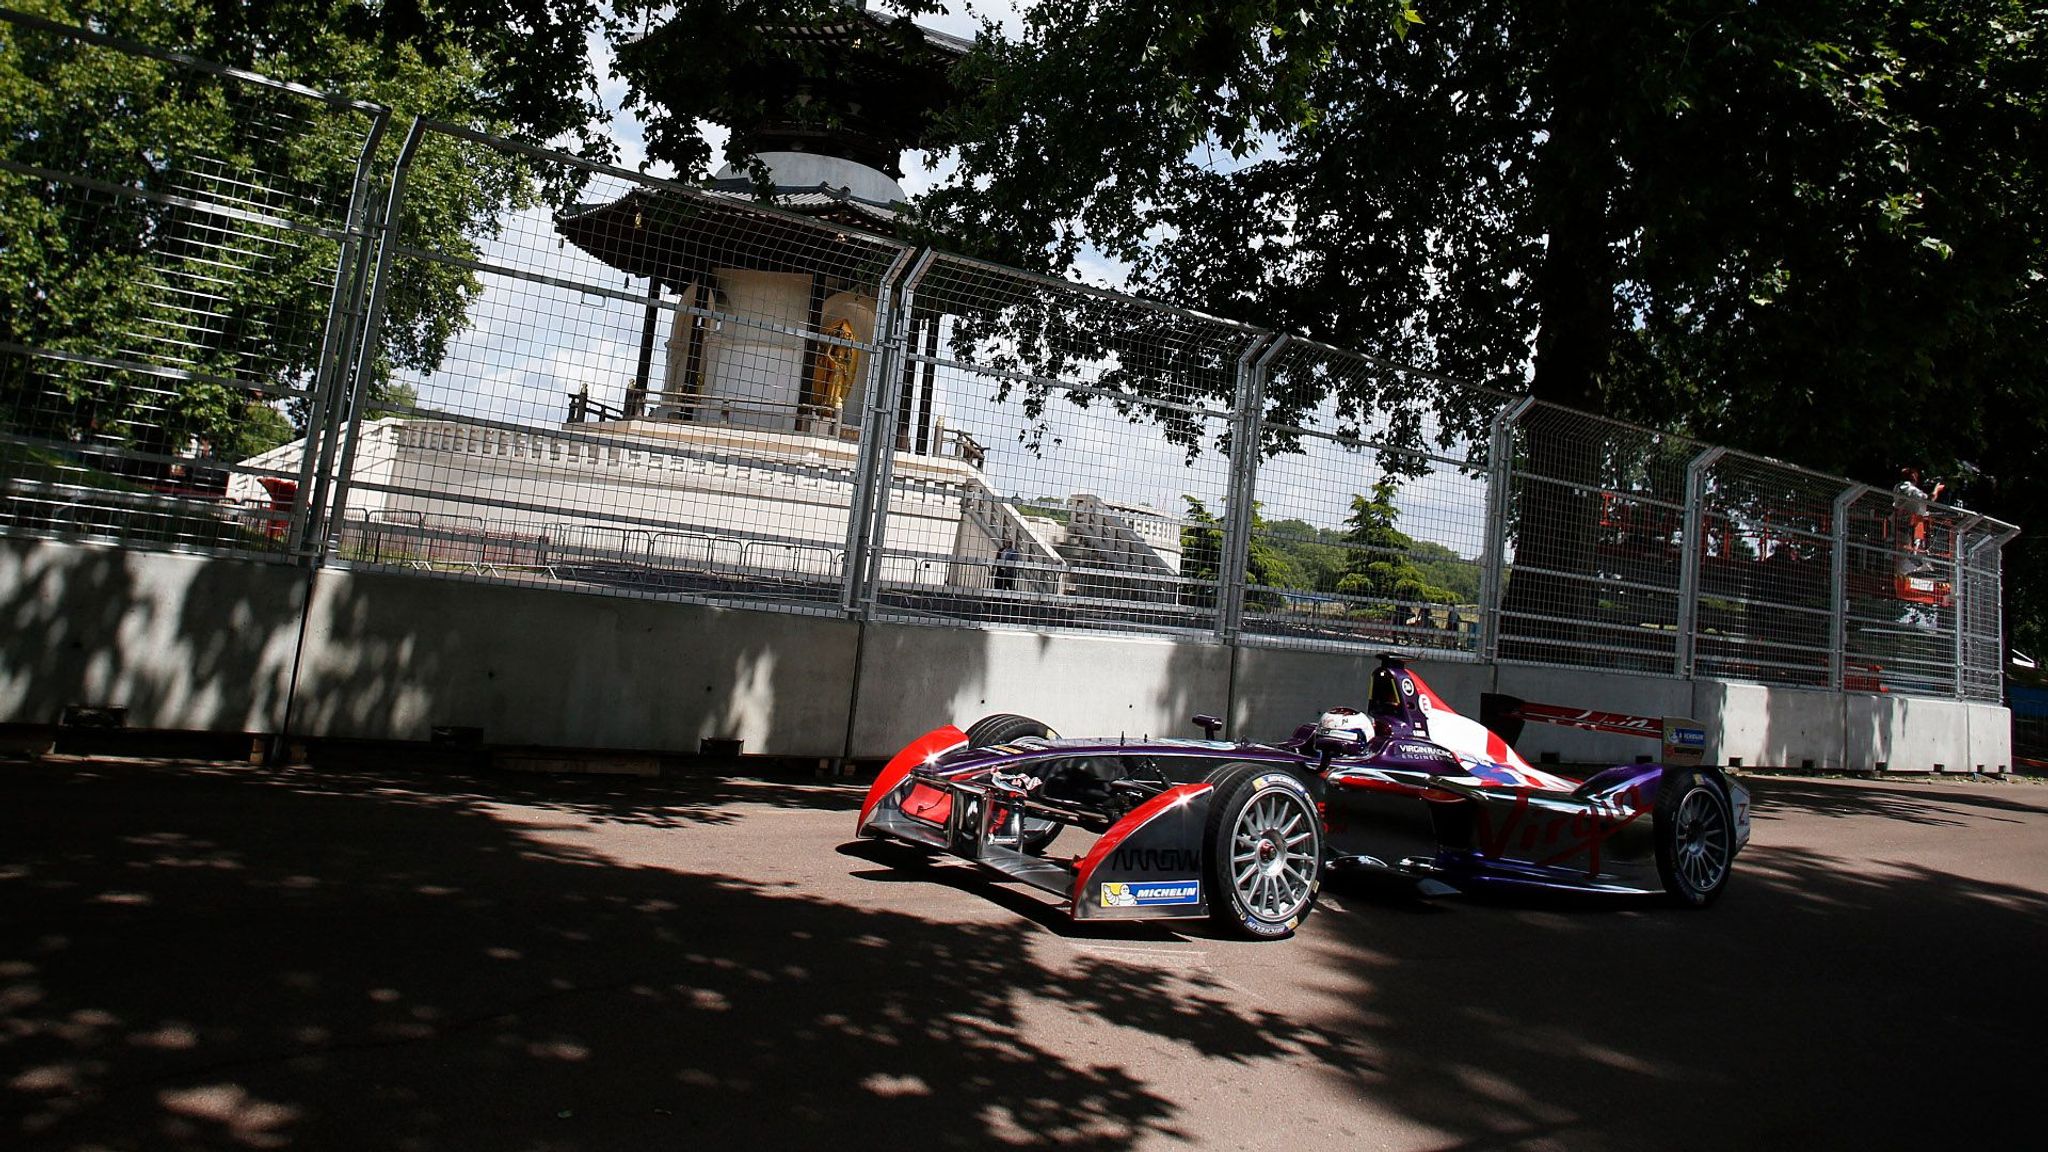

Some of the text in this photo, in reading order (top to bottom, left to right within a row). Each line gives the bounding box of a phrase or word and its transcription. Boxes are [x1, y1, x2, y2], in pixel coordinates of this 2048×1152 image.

[1399, 744, 1427, 754] VIRGIN
[1401, 753, 1455, 764] ENGINEE
[1475, 785, 1655, 879] Virgin
[1112, 849, 1200, 871] ARROW
[1136, 887, 1197, 897] MICHELIN
